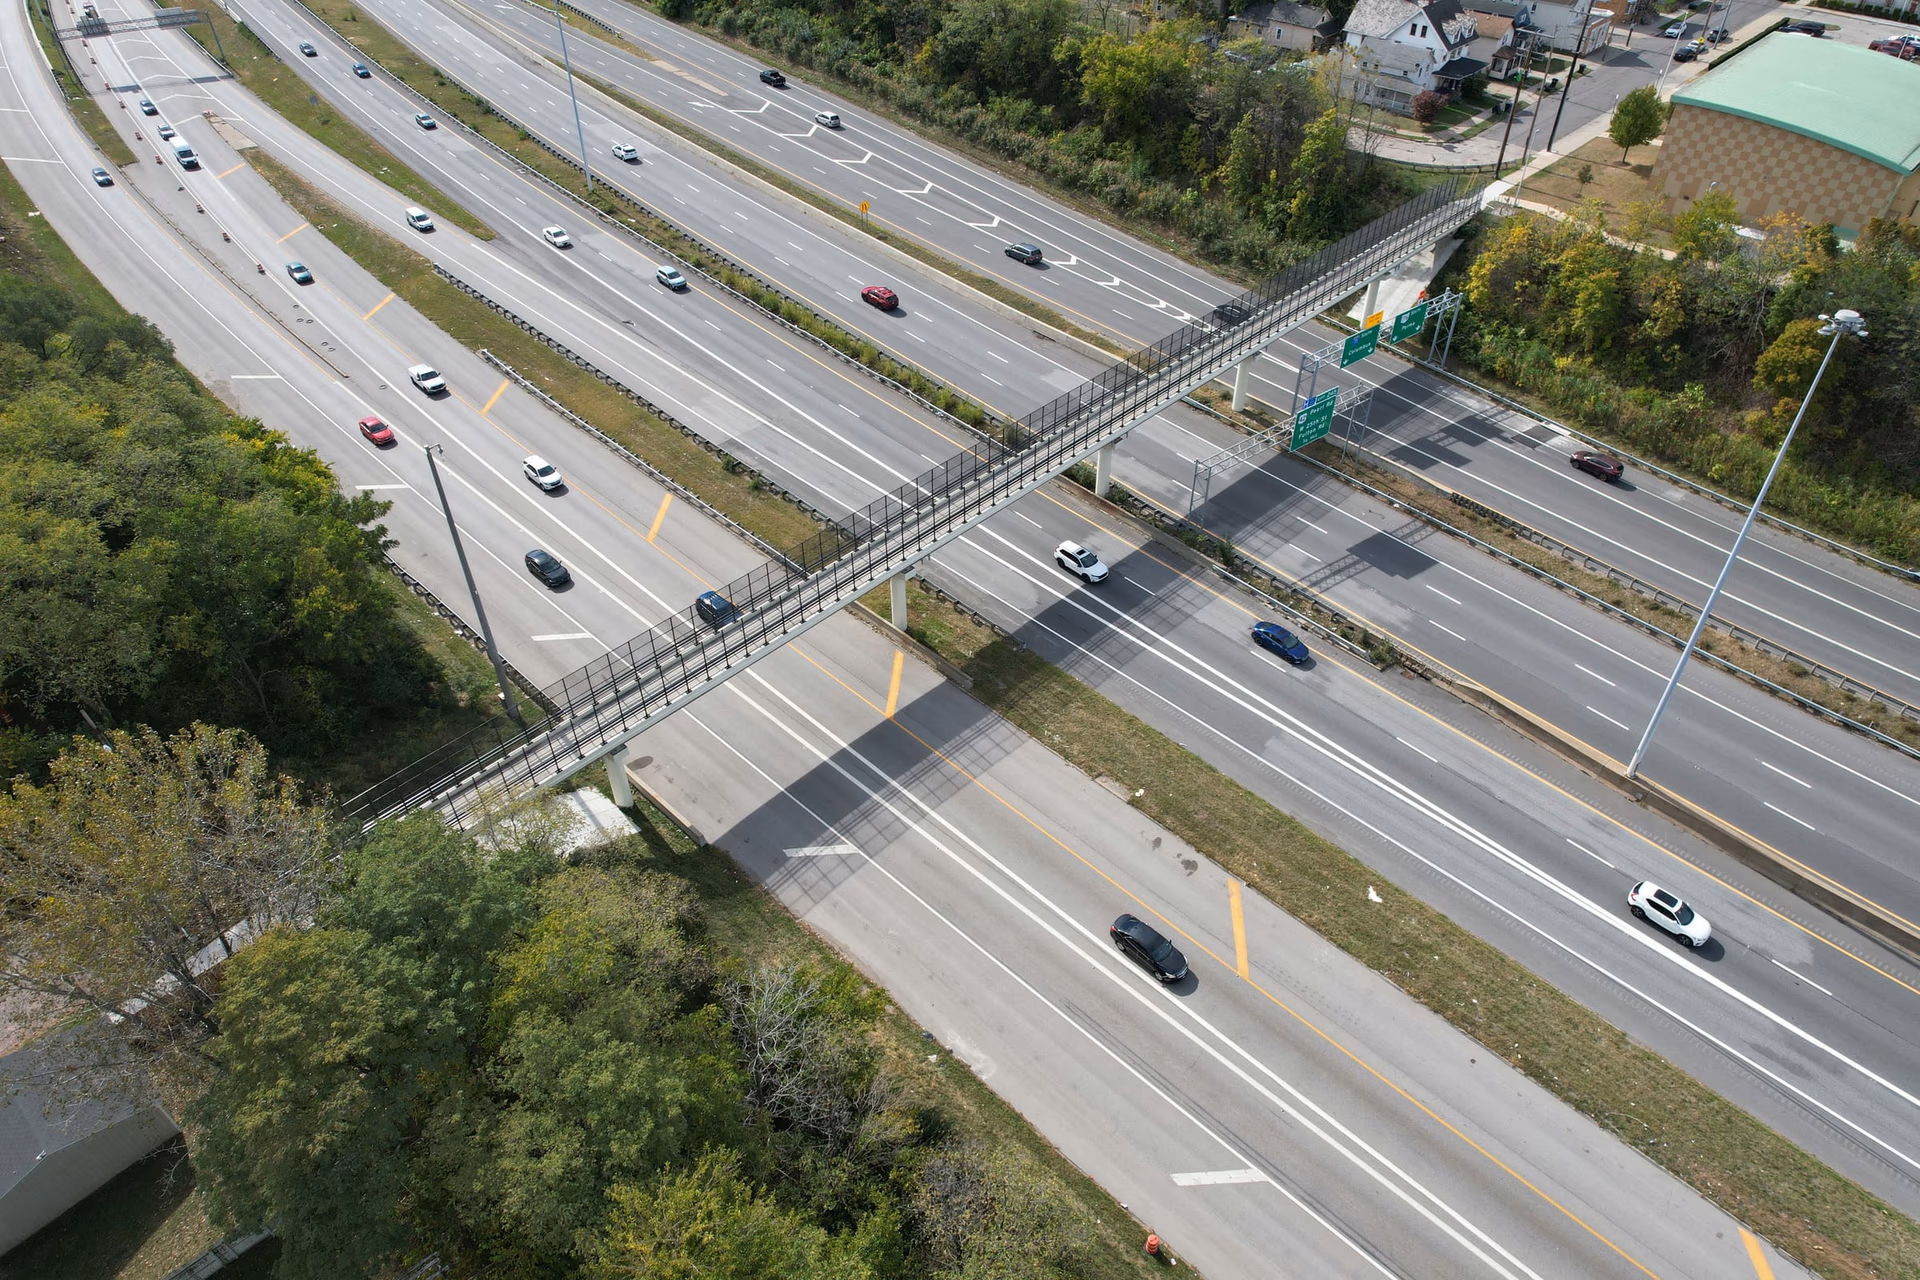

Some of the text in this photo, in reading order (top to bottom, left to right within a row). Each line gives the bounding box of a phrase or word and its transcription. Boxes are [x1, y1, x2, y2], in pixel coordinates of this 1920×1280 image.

[1348, 342, 1371, 356] Columbus
[1310, 405, 1325, 415] Pearl
[1306, 420, 1319, 429] 25th
[1298, 428, 1316, 439] Fulton
